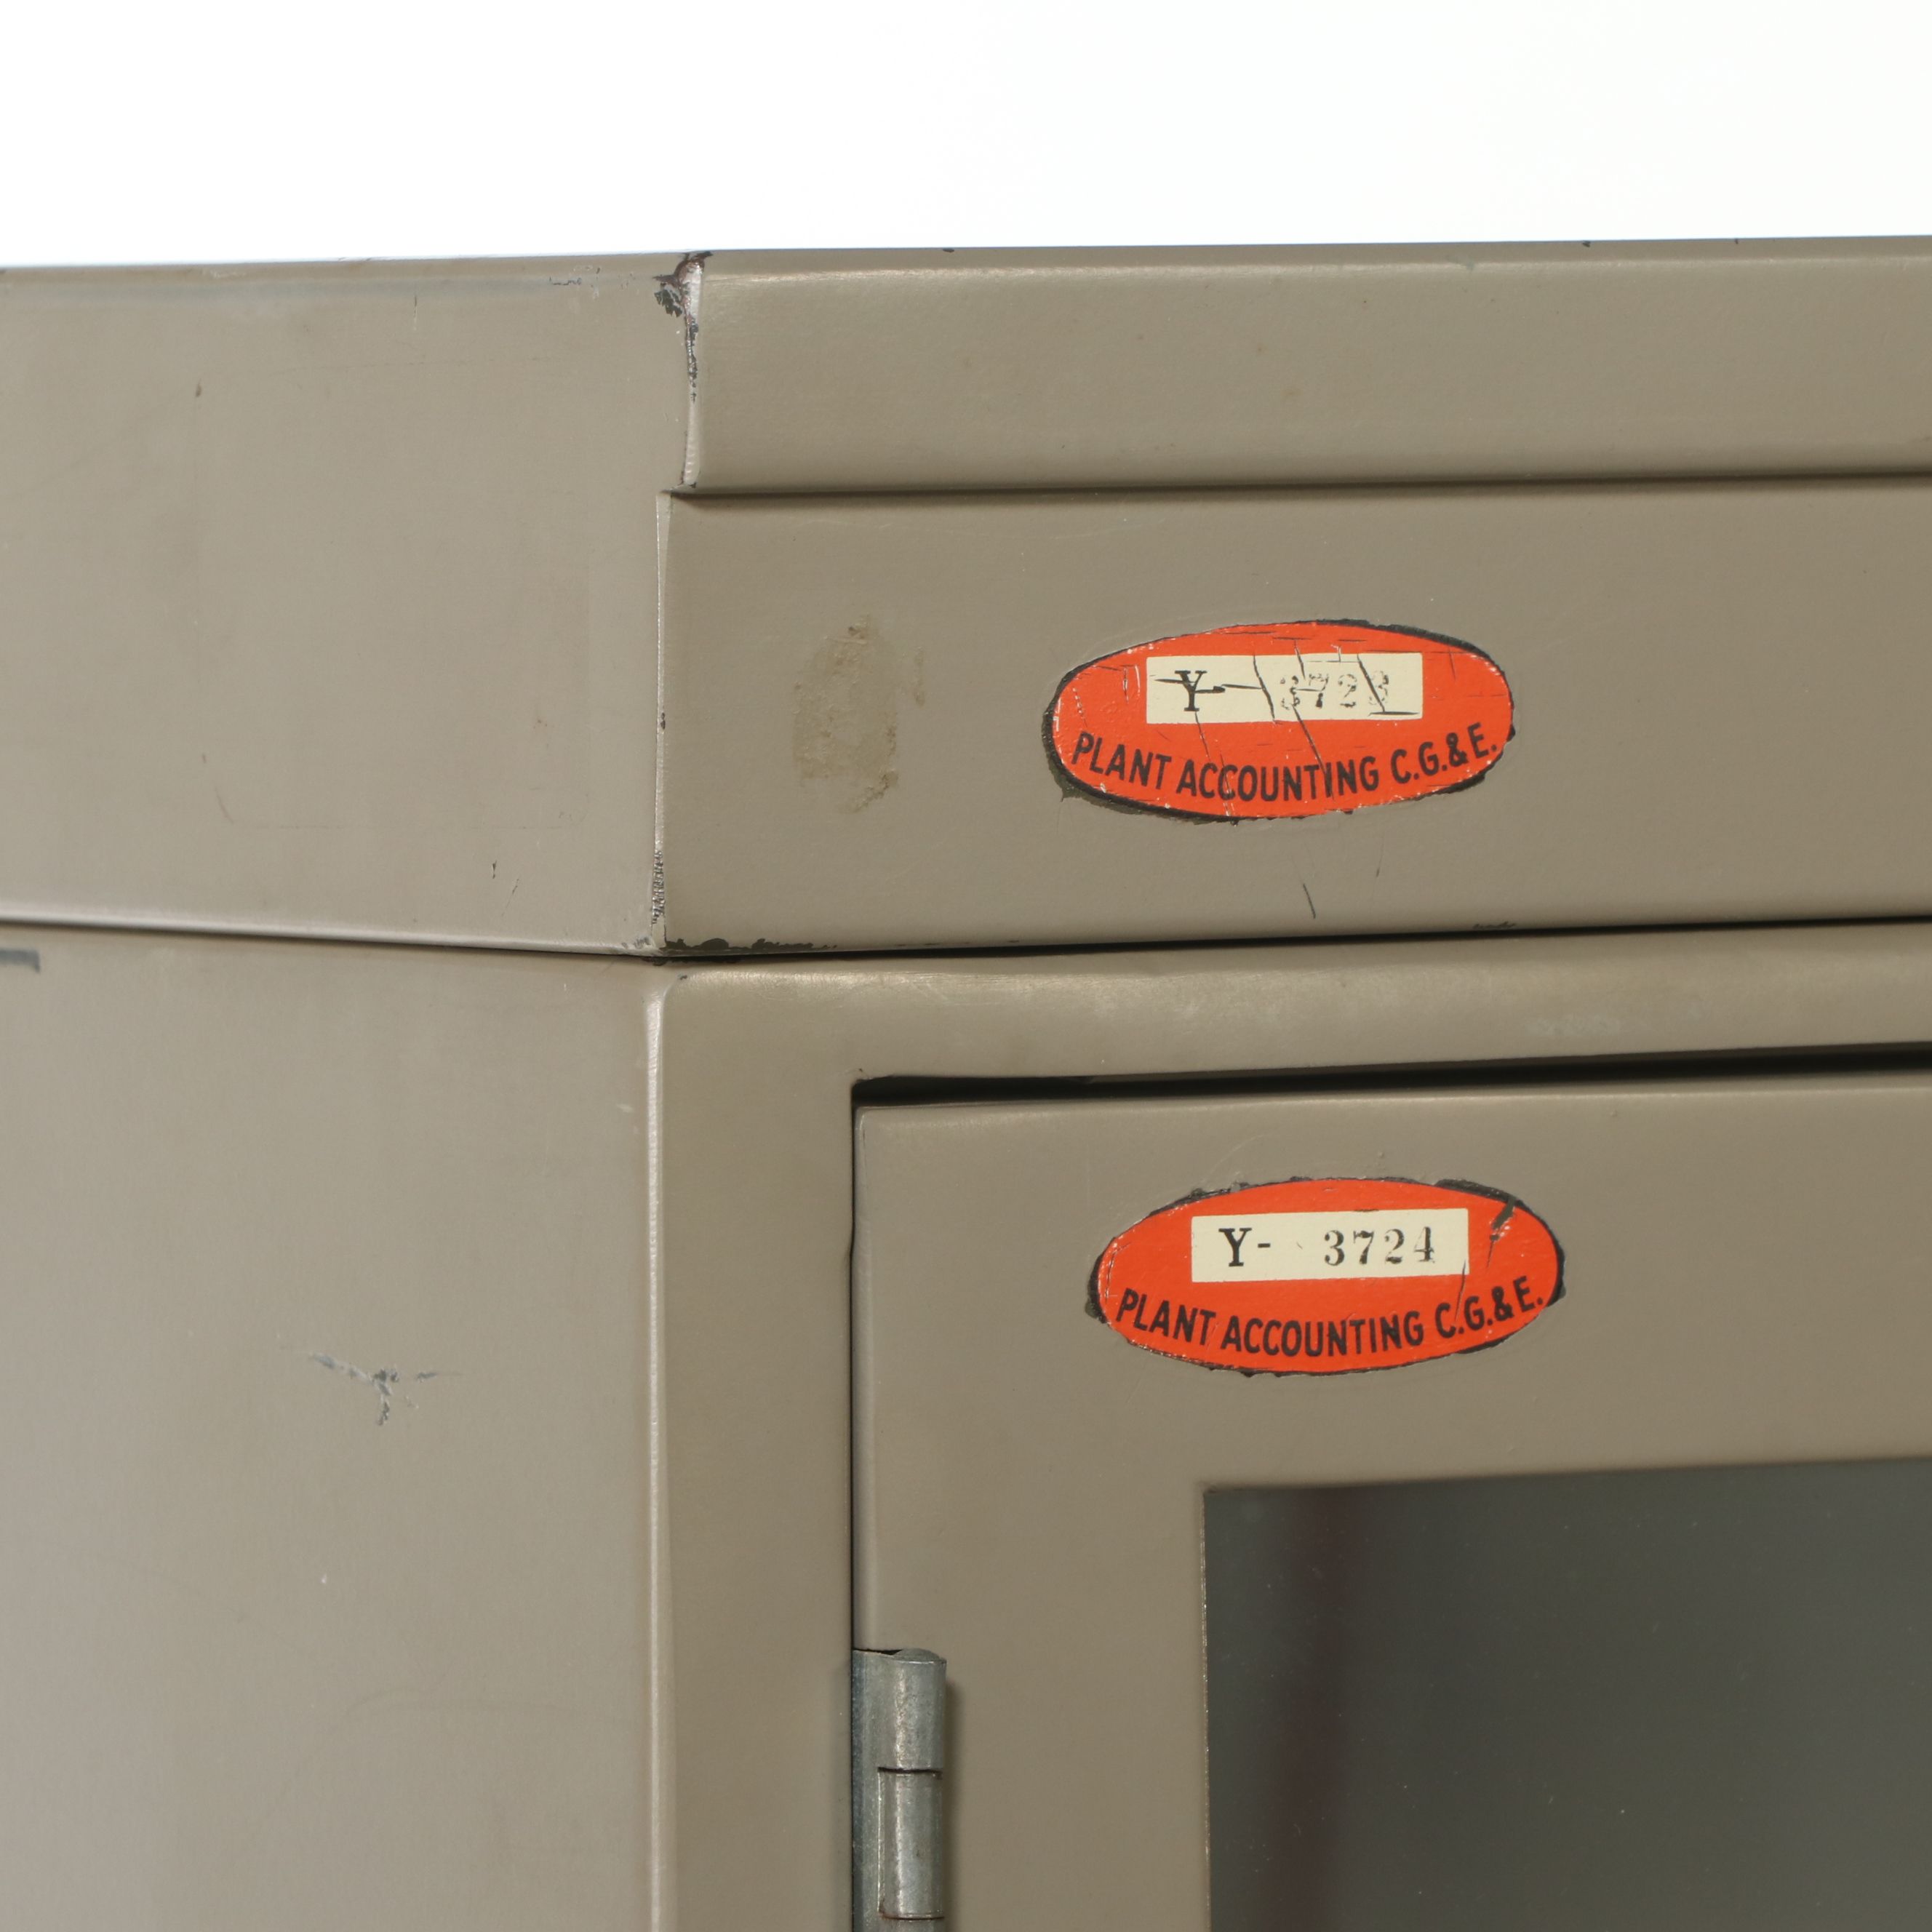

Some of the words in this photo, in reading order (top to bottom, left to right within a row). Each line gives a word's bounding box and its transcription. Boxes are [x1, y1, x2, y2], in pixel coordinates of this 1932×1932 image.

[1071, 732, 1171, 791] PLANT
[1176, 756, 1379, 801] ACCOUNTING
[1218, 1227, 1272, 1267] Y-
[1323, 1226, 1436, 1266] 3724
[1116, 1288, 1216, 1346] PLANT
[1221, 1312, 1424, 1357] ACCOUNTING
